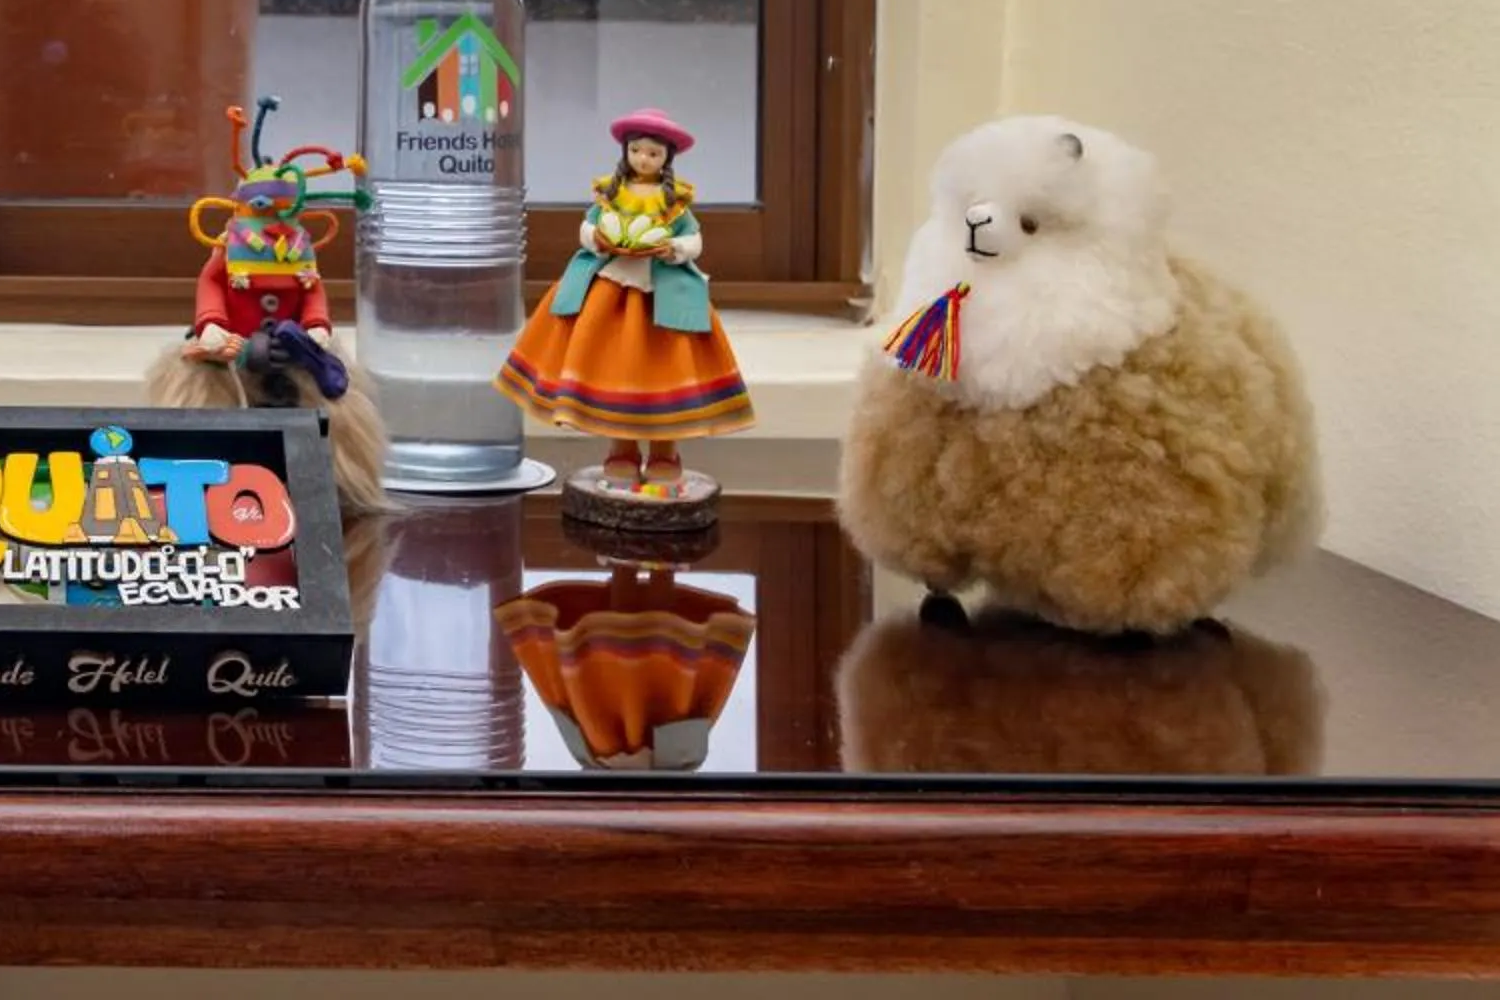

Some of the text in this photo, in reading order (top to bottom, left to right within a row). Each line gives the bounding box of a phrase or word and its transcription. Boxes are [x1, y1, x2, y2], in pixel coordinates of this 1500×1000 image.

[397, 131, 521, 151] Friends Hot
[439, 154, 496, 174] Quito
[117, 578, 300, 610] ECUADOR
[67, 654, 170, 693] Hotel
[206, 655, 296, 696] Quito
